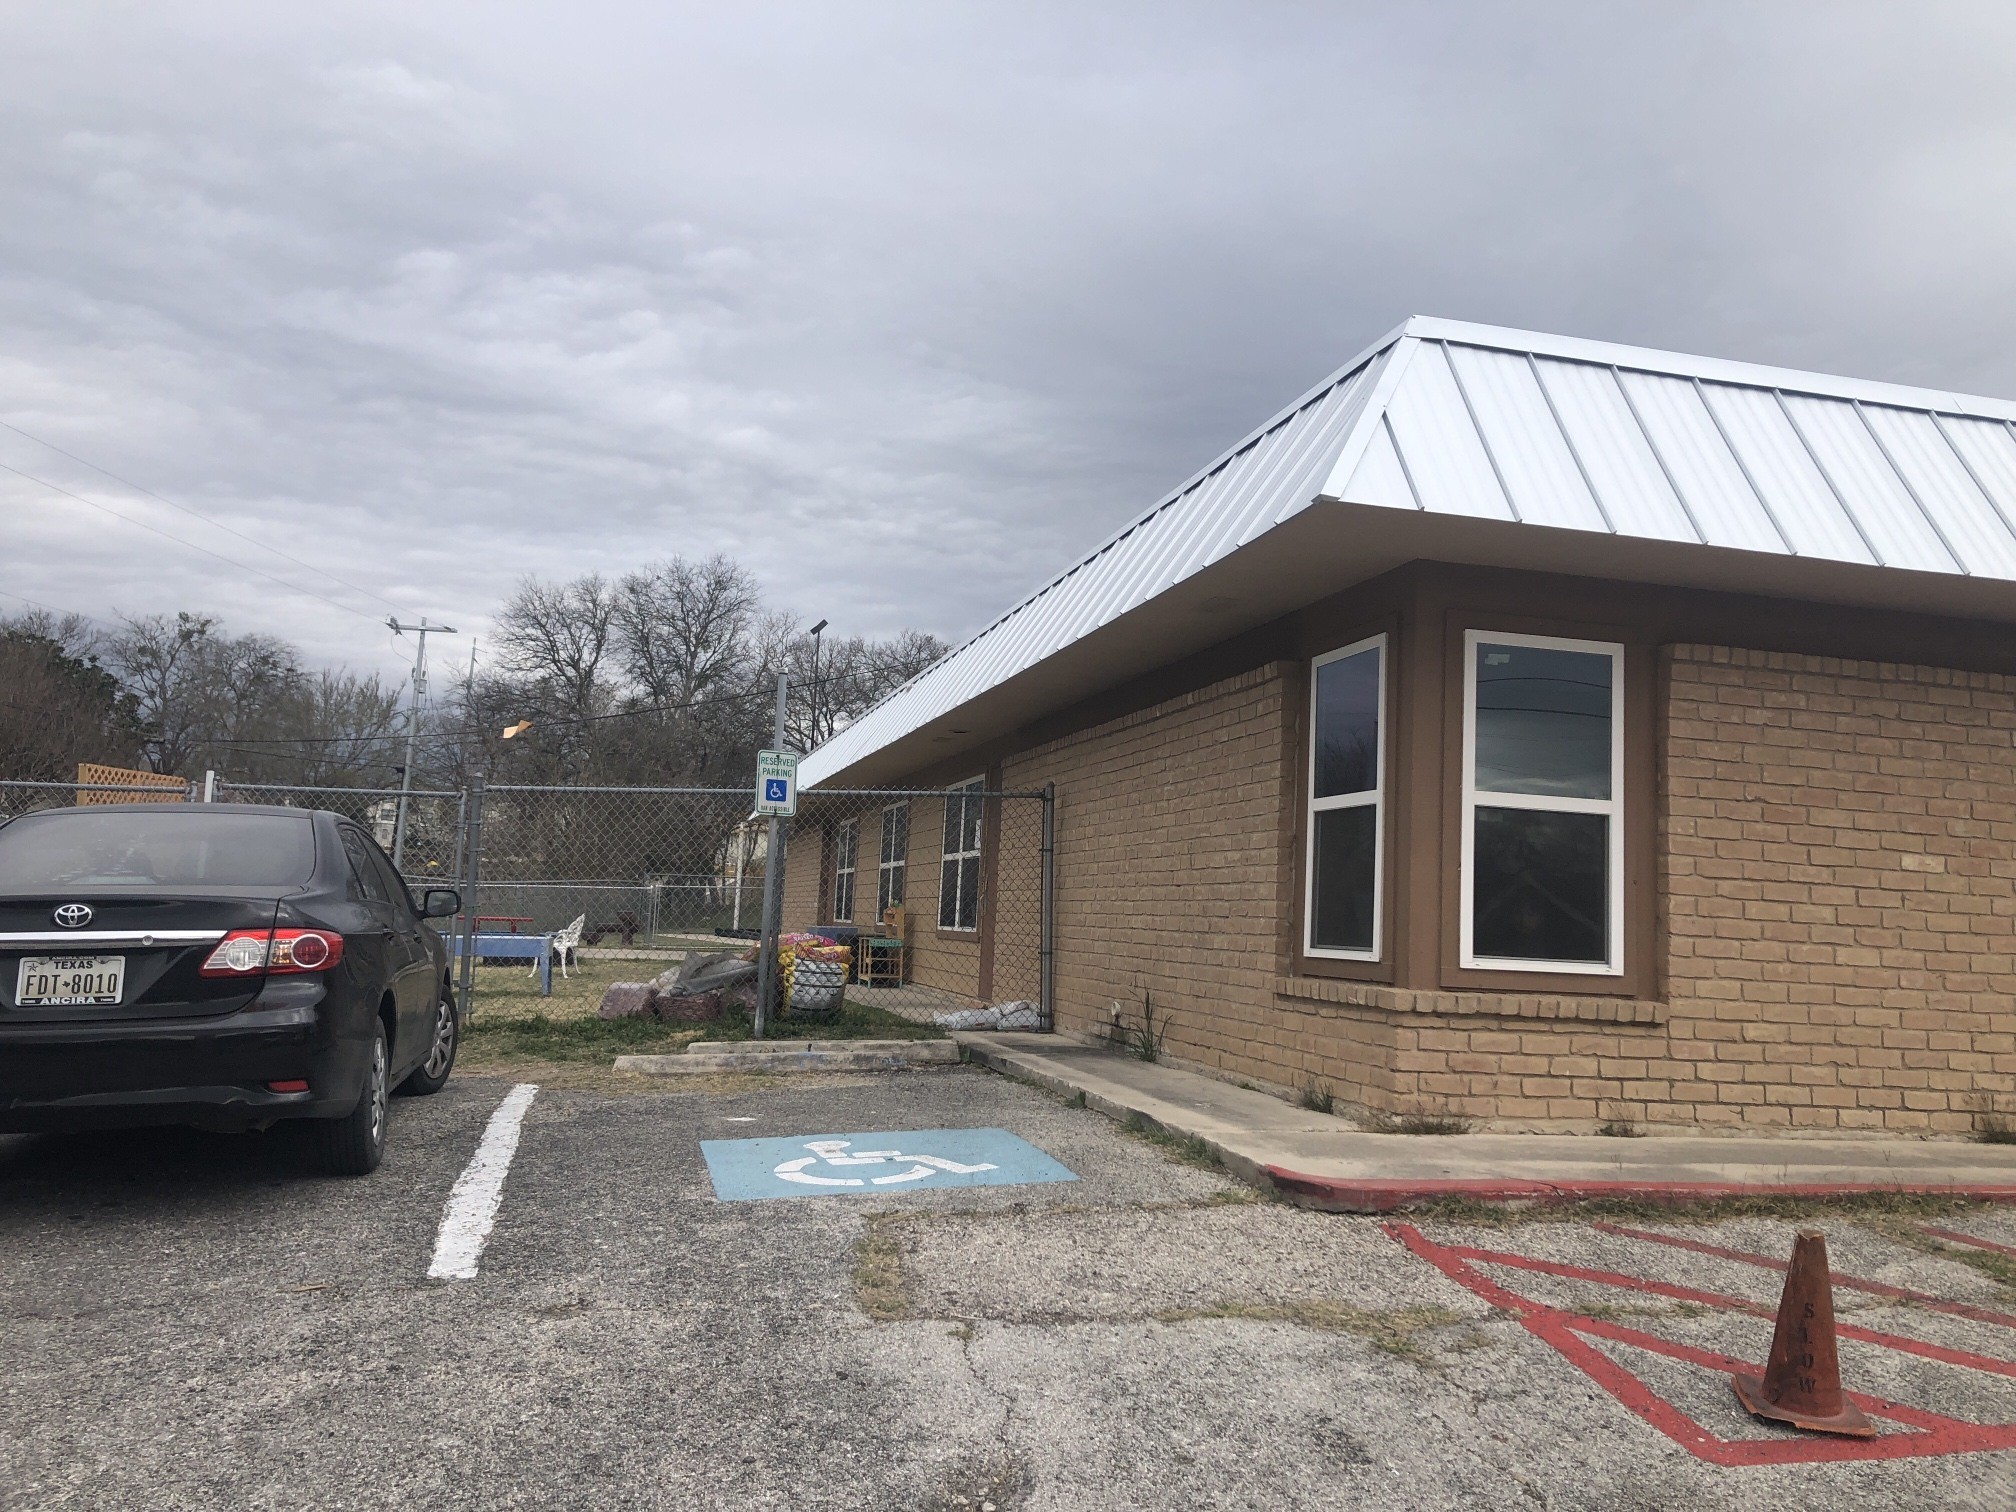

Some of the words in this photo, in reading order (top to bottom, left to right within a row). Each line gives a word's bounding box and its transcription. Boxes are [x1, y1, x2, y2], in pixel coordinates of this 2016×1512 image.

[761, 756, 795, 767] RESERVED
[762, 767, 793, 778] PARKING
[53, 960, 94, 970] TEXAS
[39, 996, 96, 1005] ANCIRA
